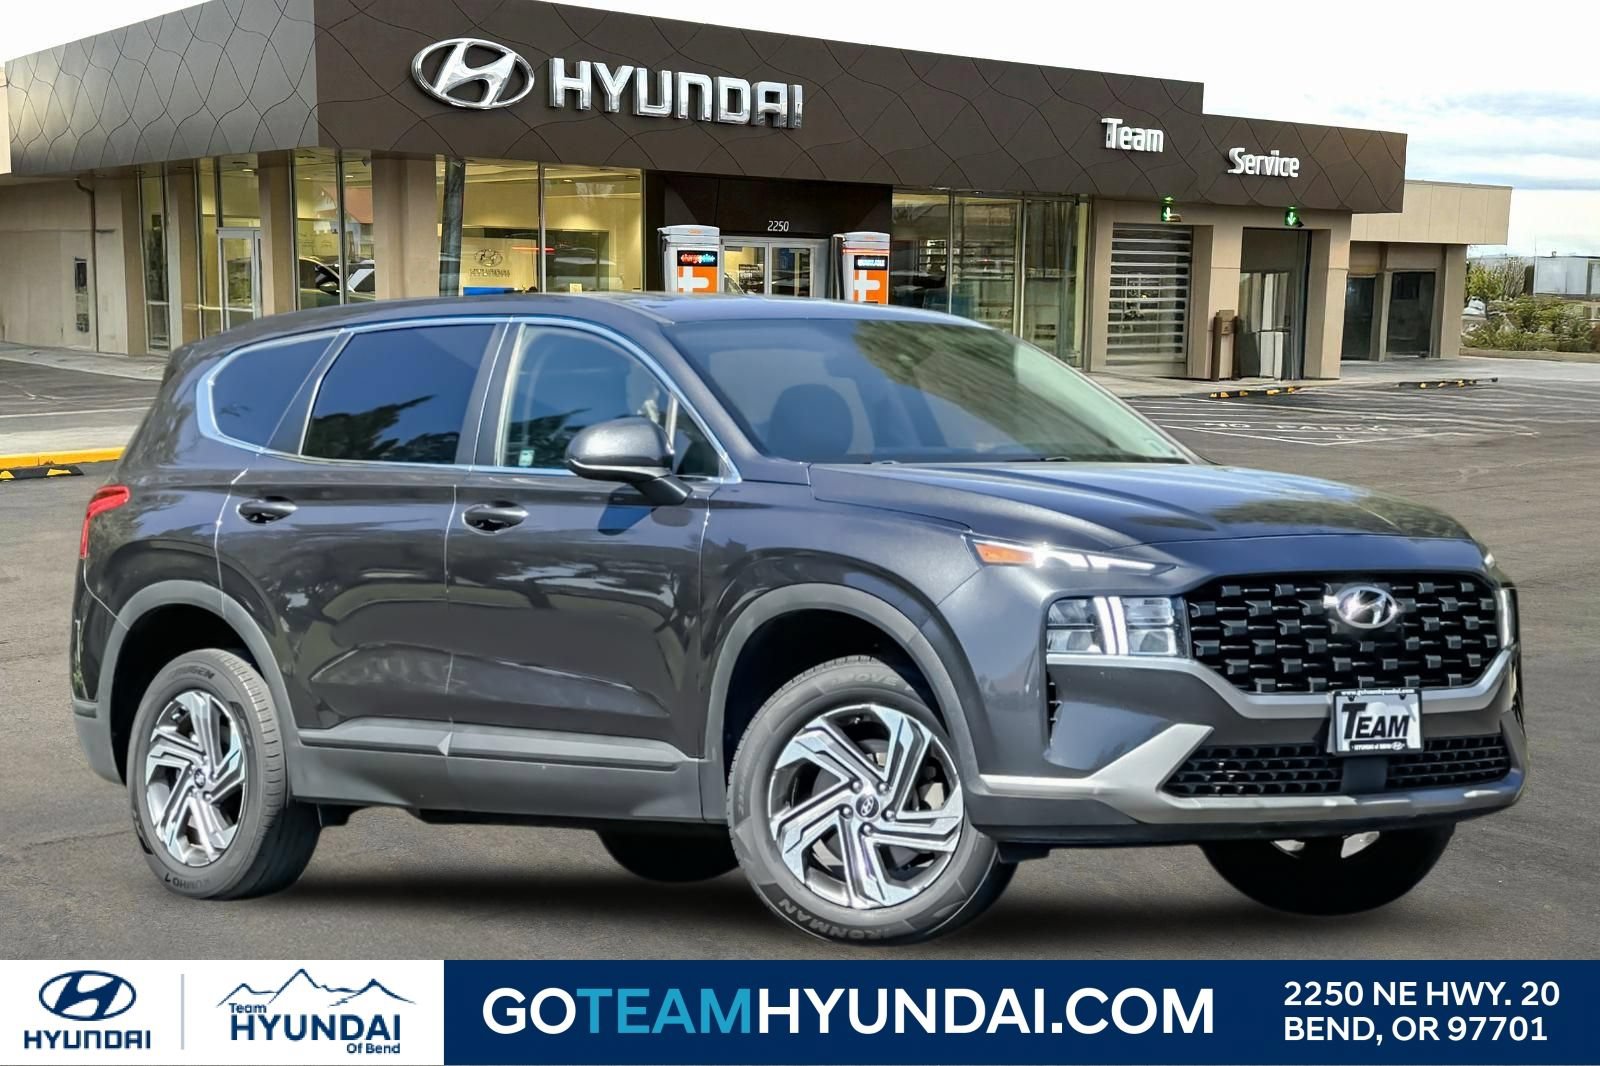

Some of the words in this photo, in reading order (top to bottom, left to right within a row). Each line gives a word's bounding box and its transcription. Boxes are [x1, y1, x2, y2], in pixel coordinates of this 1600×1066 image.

[548, 57, 803, 129] HYUNDAI
[1101, 117, 1164, 153] Team
[1227, 147, 1300, 178] Service
[767, 220, 790, 232] 2250
[1341, 703, 1410, 739] TEAM
